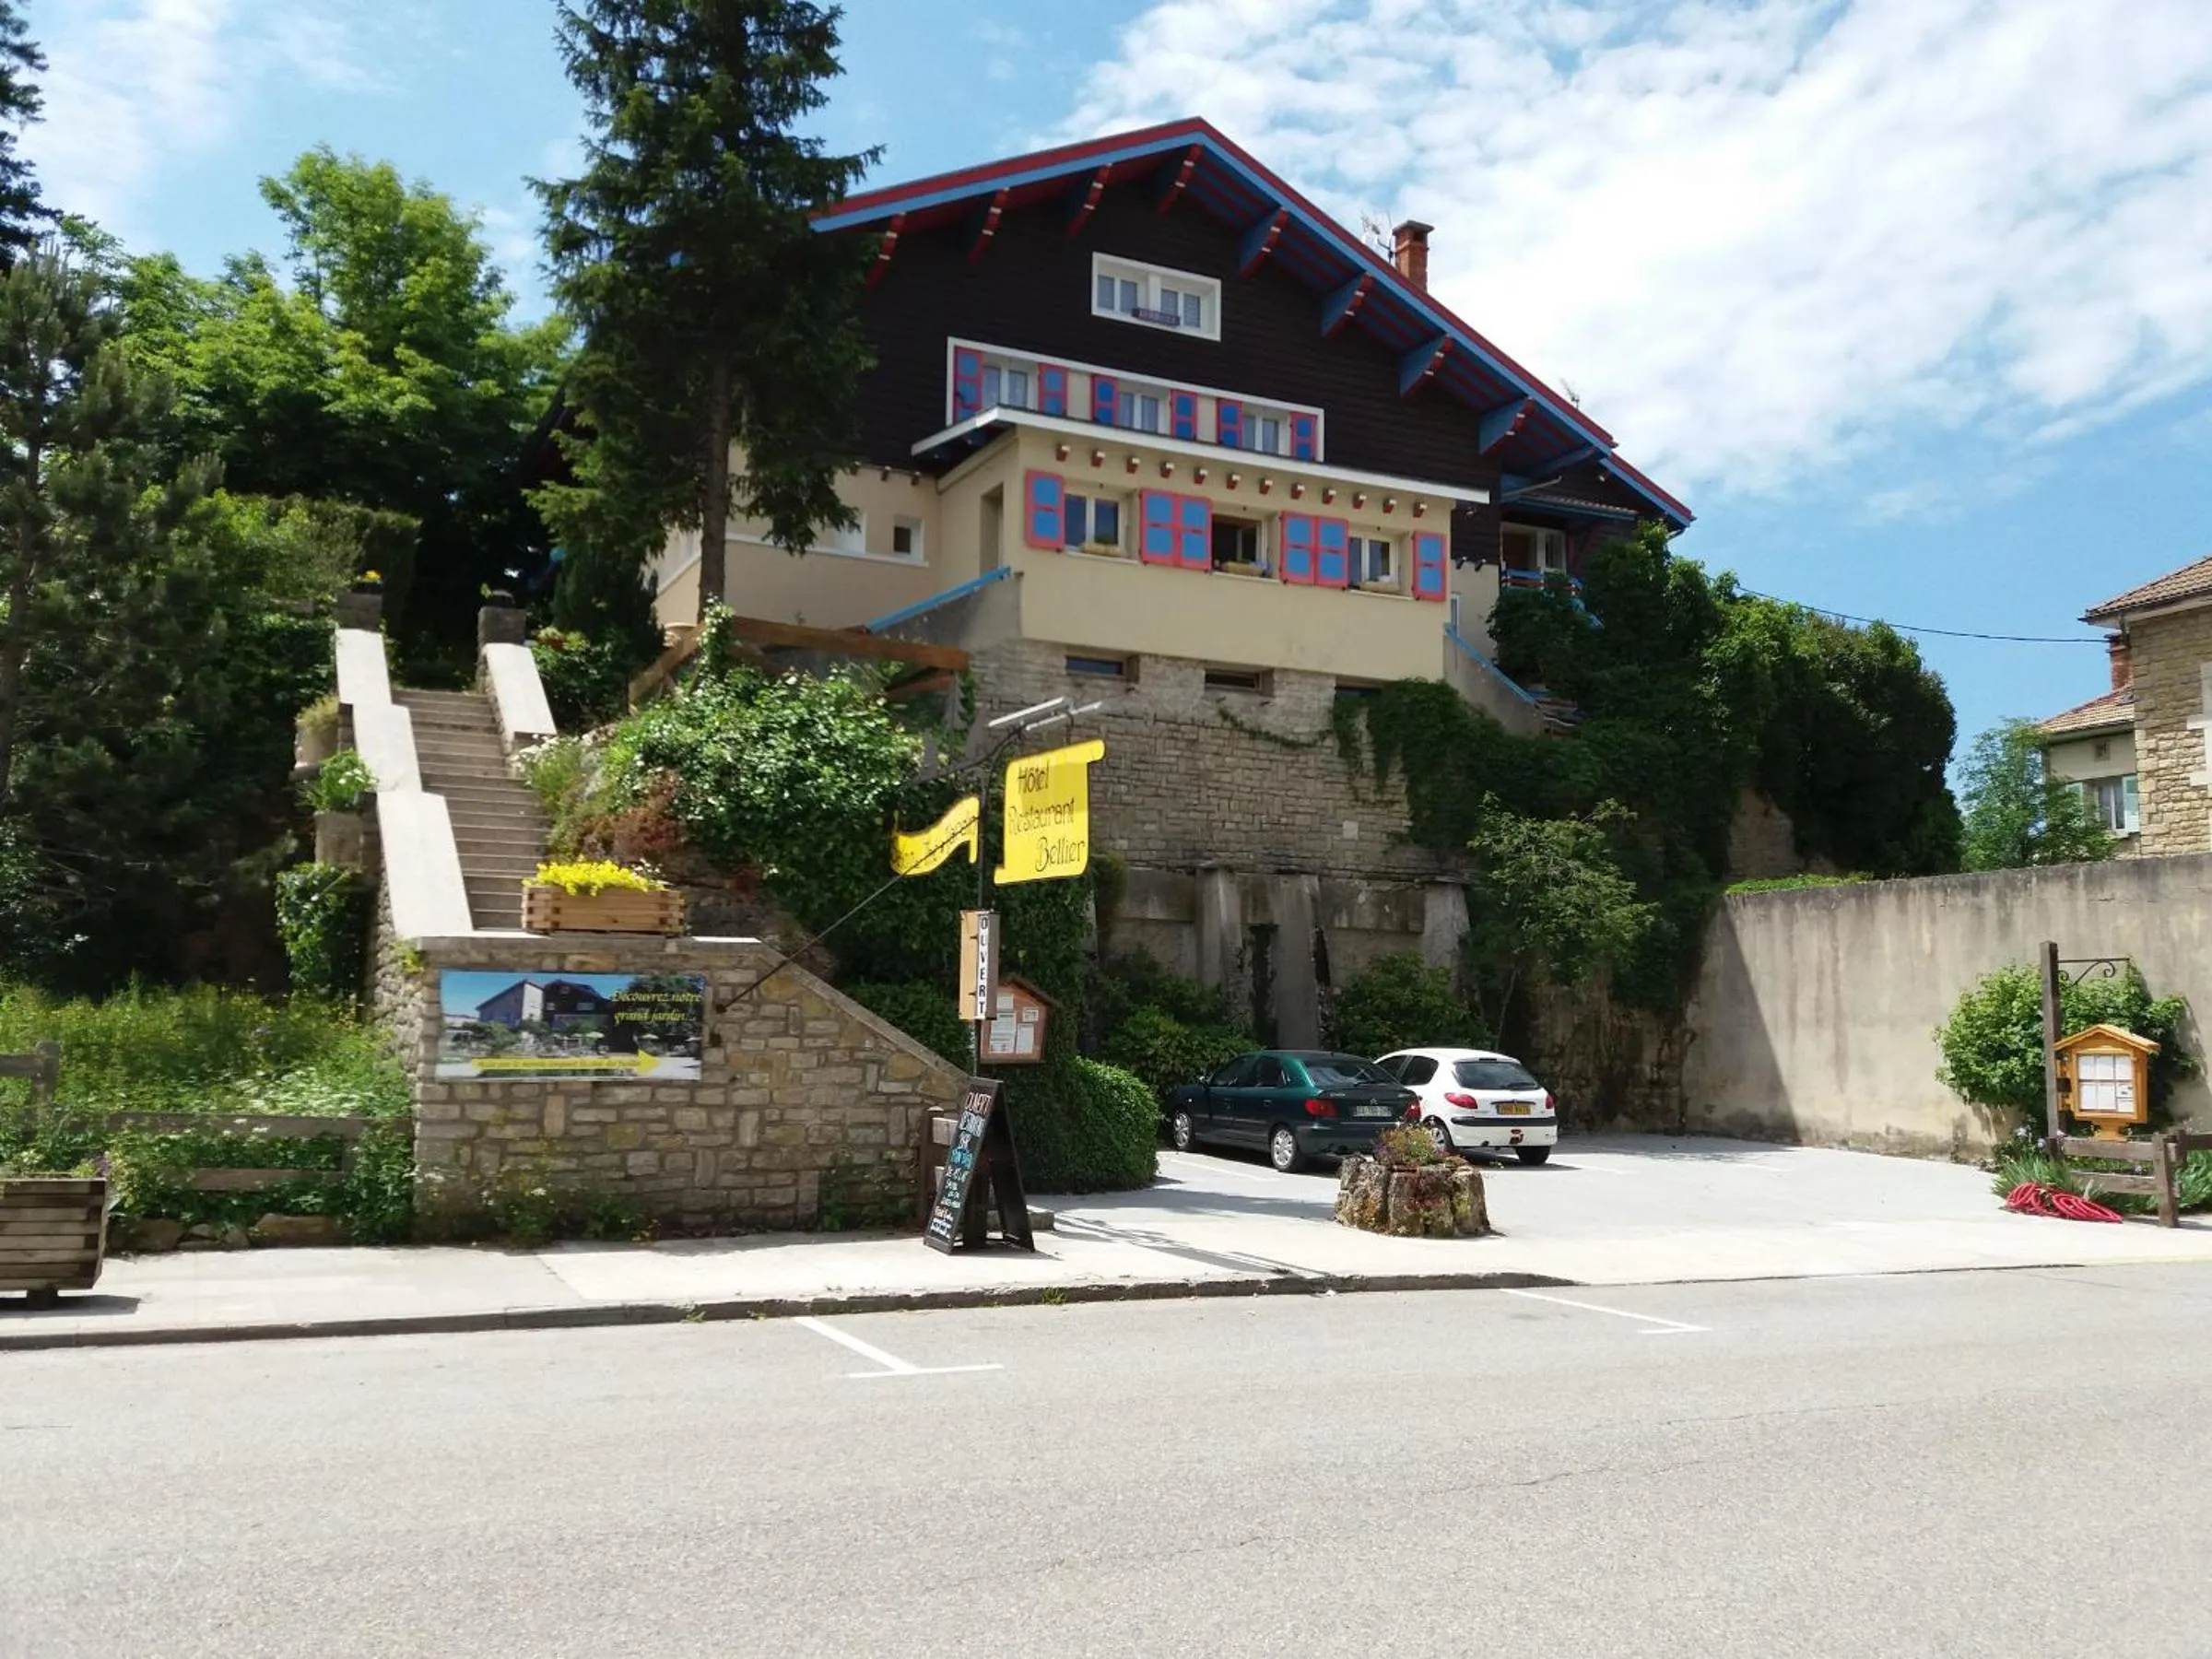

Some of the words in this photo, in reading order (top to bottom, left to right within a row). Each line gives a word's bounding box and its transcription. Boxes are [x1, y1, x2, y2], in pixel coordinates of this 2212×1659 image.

[1017, 759, 1050, 794] Hôtel
[1008, 797, 1075, 835] Restaurant
[1035, 836, 1086, 872] Bellier
[978, 916, 989, 1014] OUVERT
